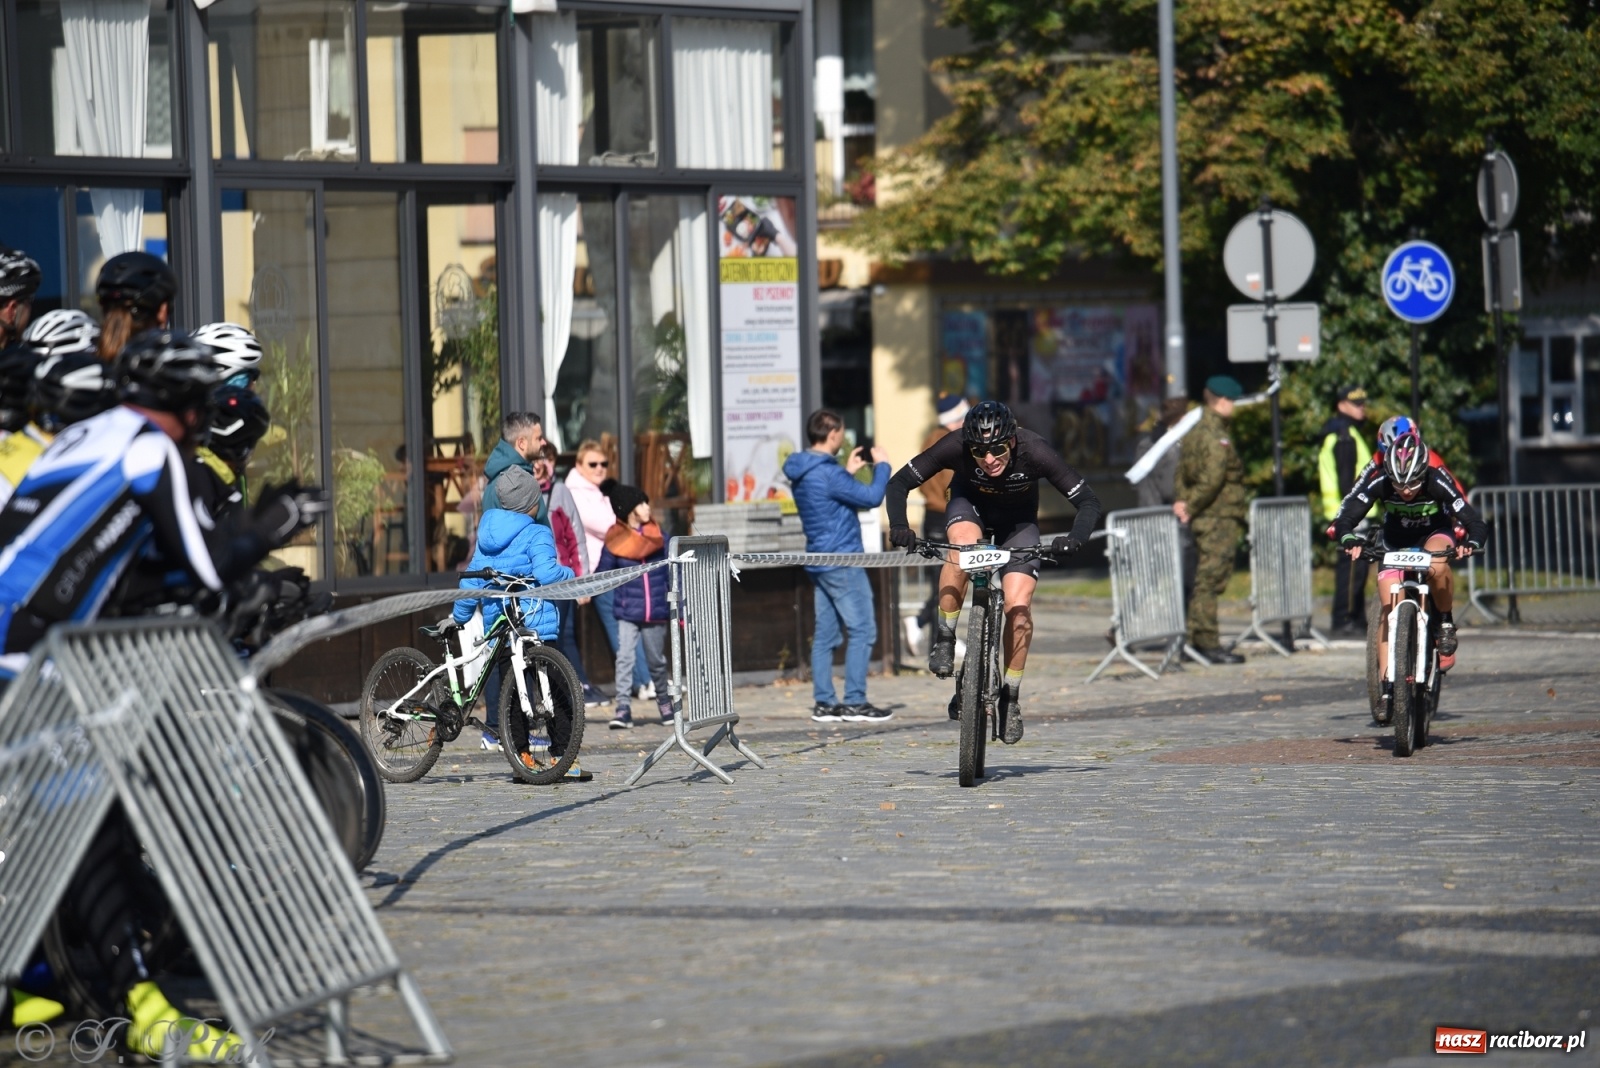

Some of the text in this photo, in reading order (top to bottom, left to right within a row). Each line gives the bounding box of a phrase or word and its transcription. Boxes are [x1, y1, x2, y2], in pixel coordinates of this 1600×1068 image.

[720, 262, 794, 282] CATERING DIETETYCZNY
[968, 553, 1002, 565] 2029
[1393, 554, 1424, 563] 3269
